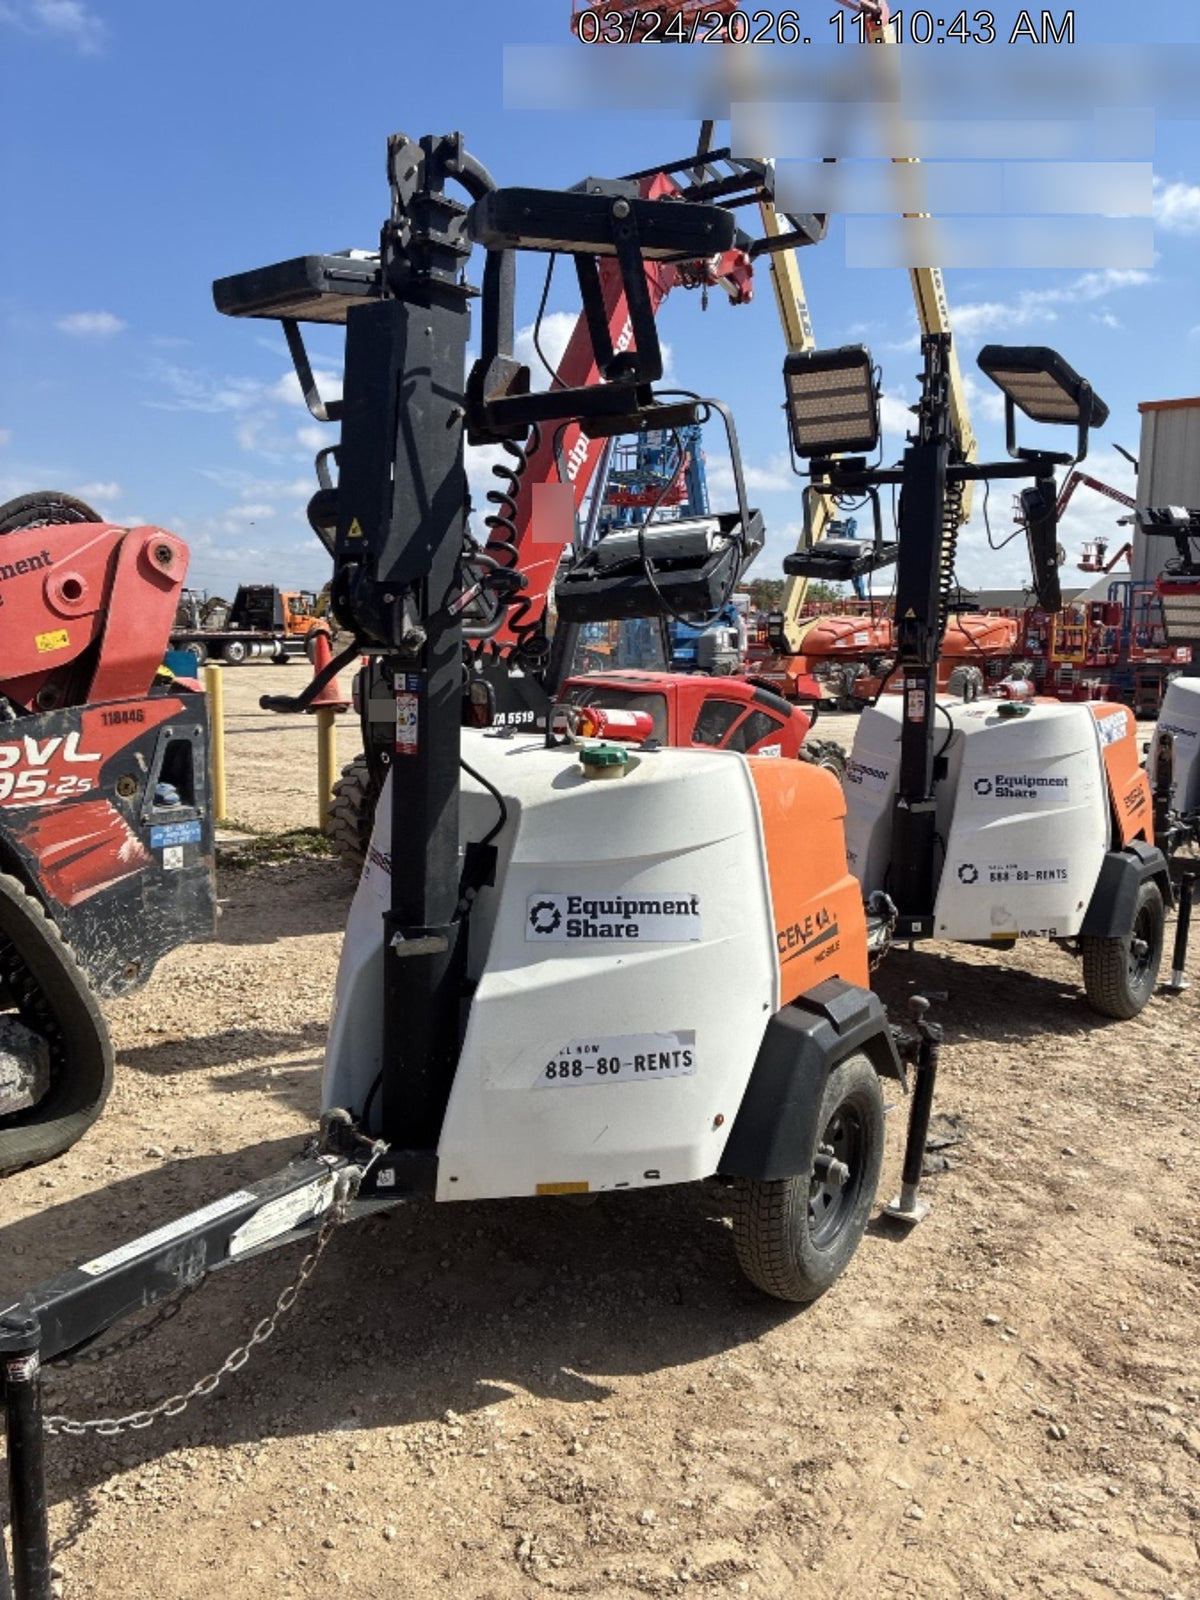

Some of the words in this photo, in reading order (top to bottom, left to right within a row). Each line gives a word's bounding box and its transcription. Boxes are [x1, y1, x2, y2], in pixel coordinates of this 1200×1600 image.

[994, 775, 1068, 788] Equipment
[995, 787, 1037, 798] Share
[566, 896, 699, 919] Equipment
[566, 919, 639, 938] Share
[545, 1050, 693, 1079] 888-80-RENTS
